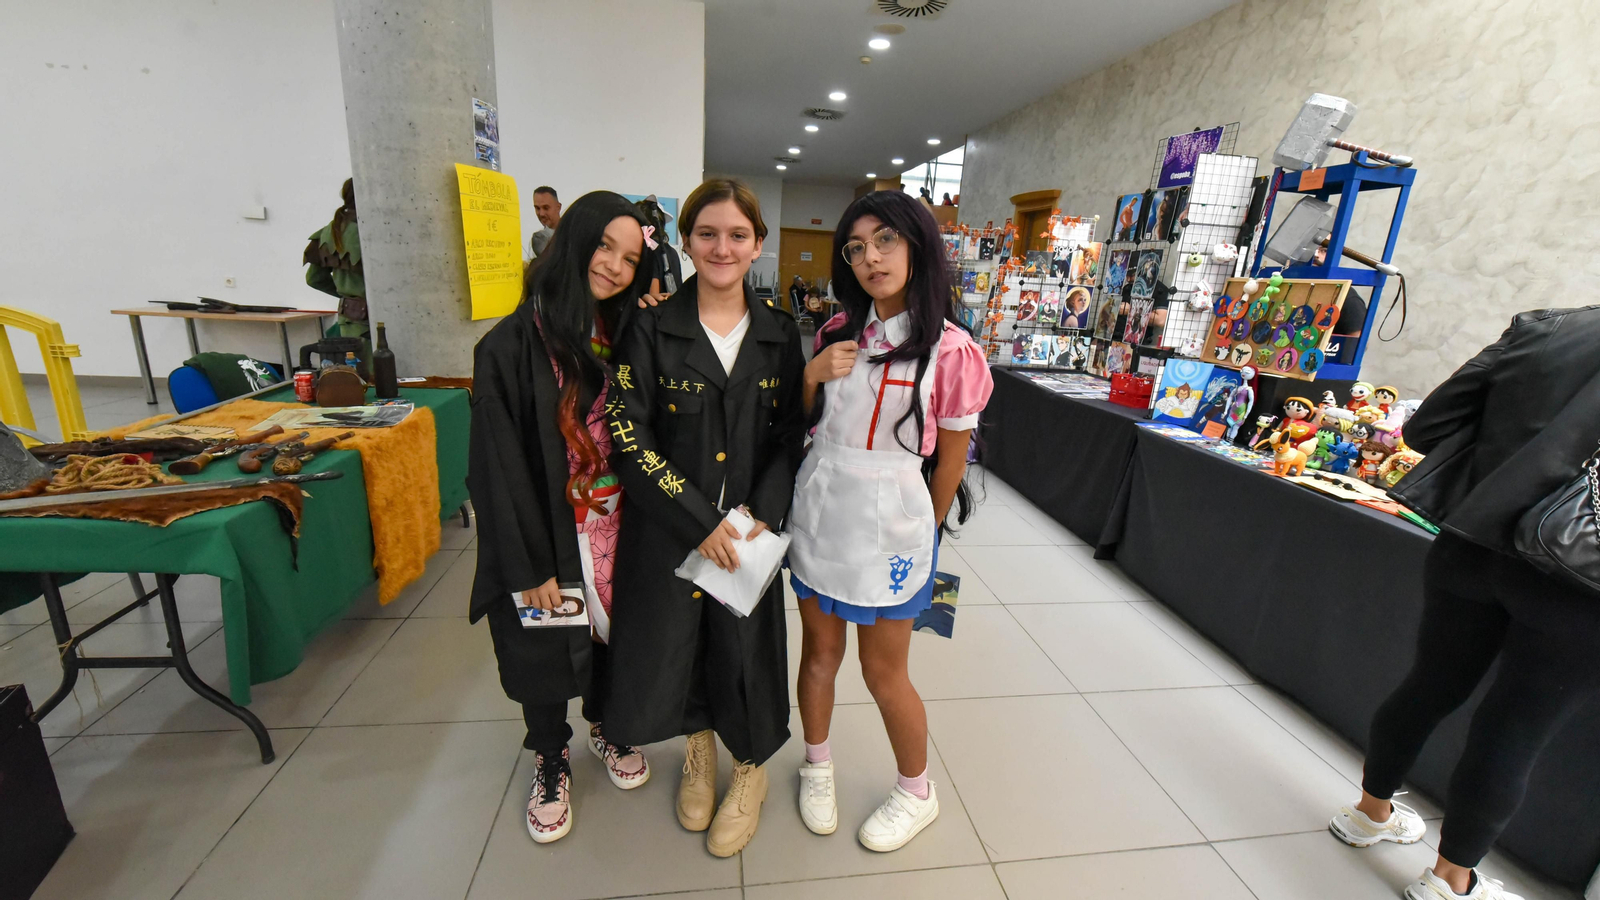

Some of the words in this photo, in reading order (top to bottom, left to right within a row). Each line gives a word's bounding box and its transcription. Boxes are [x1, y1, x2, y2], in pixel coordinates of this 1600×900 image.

[463, 172, 512, 201] TÓMBOLA
[487, 218, 498, 232] 1€
[1325, 342, 1340, 352] LA
[658, 376, 705, 394] 天上天下
